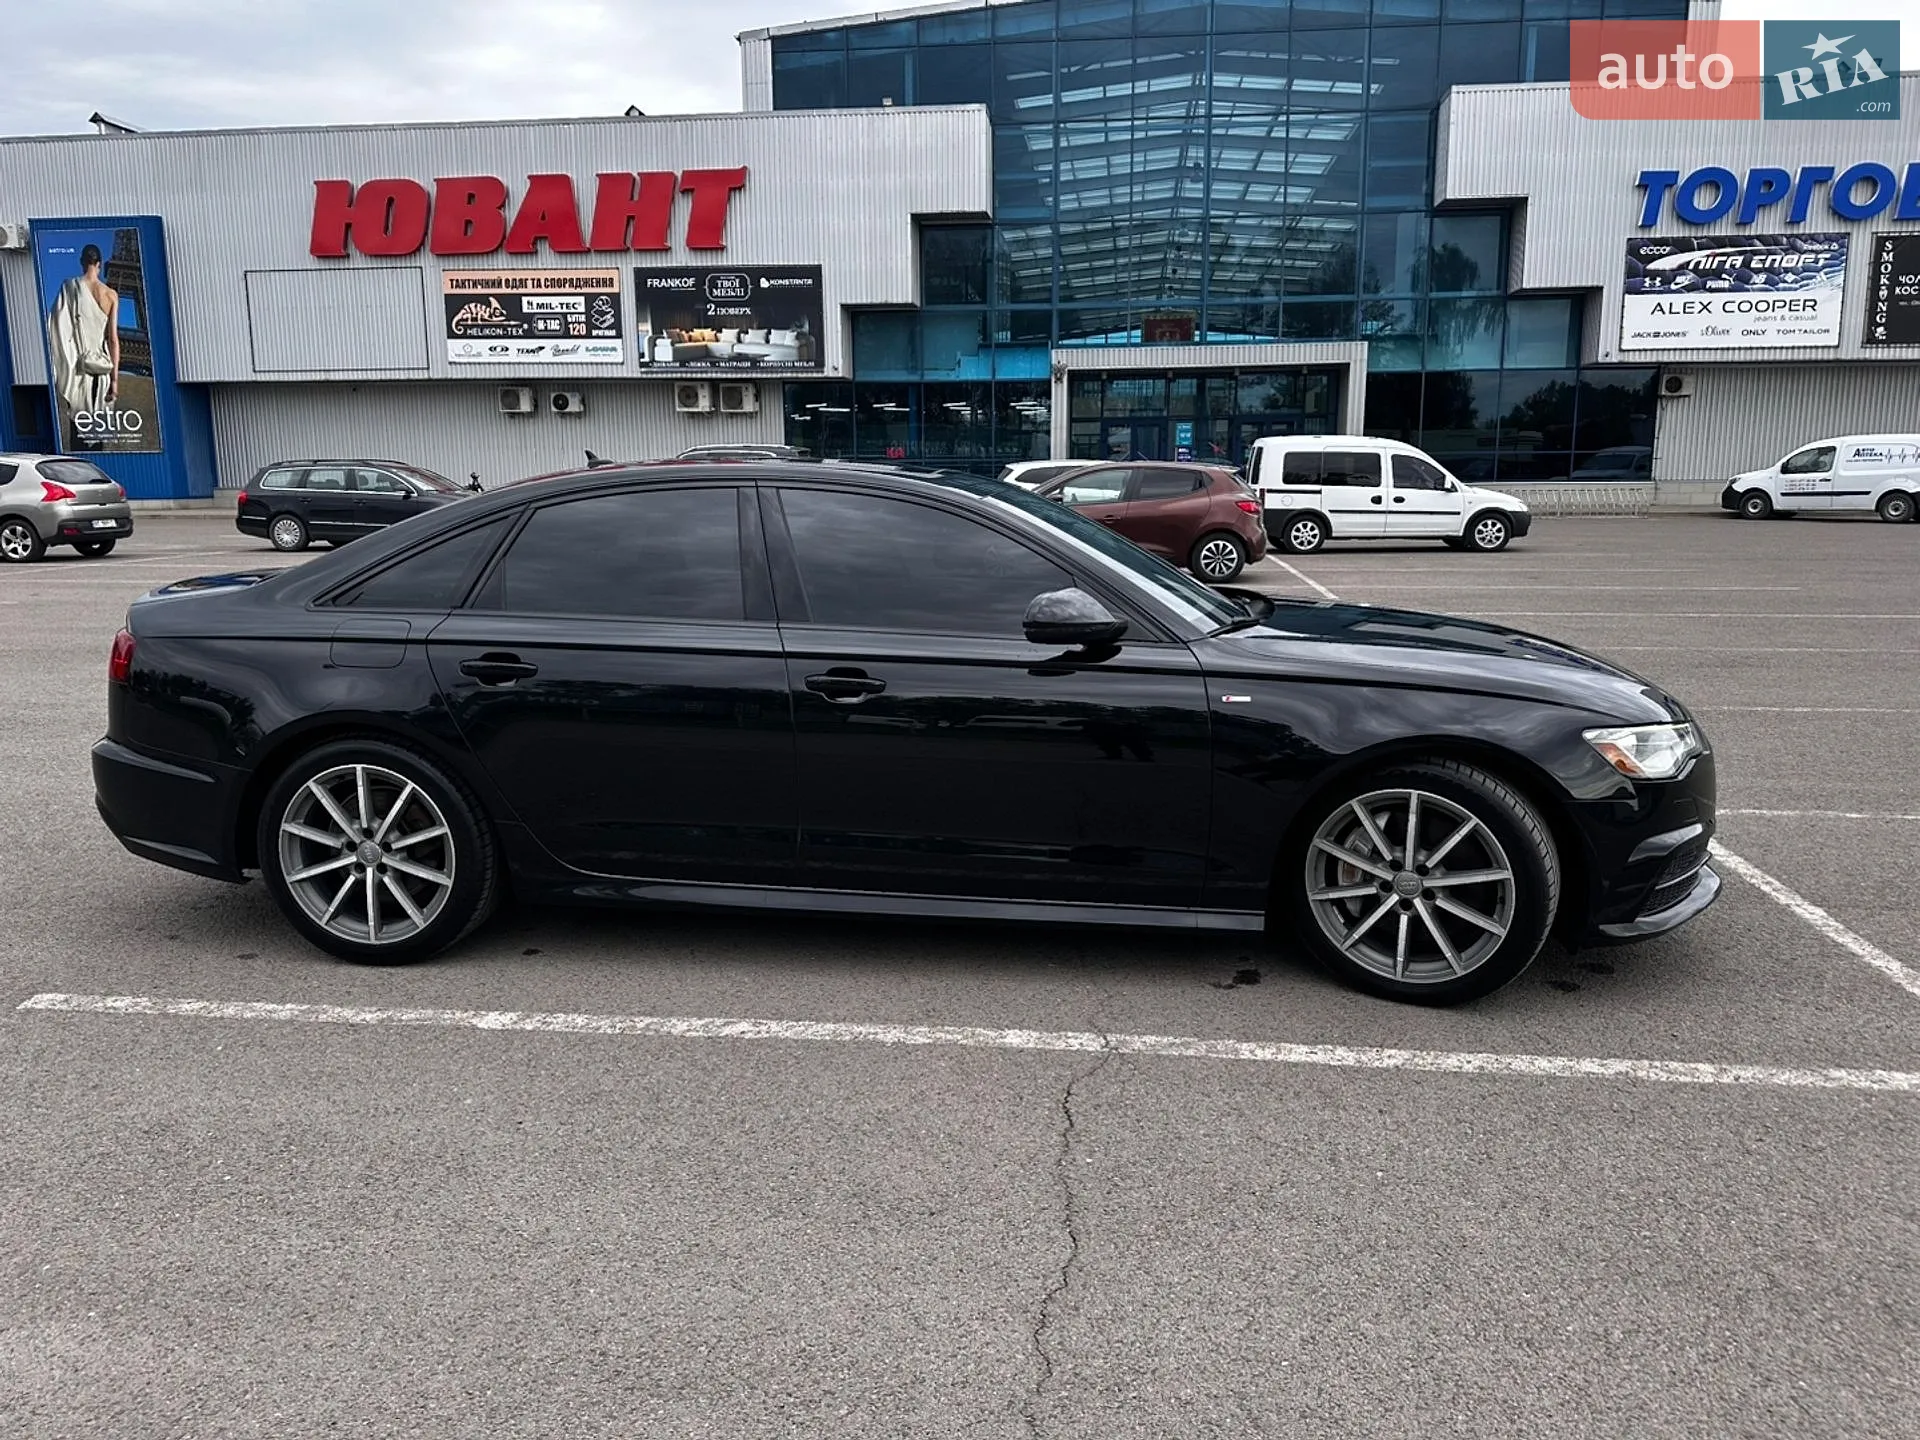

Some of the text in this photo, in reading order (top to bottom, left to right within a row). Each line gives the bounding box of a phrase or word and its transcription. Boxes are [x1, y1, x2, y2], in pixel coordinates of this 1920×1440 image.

[309, 165, 748, 258] ЮВАНТ
[1639, 245, 1671, 255] ecco
[449, 276, 614, 291] ТАКТИЧНИЙ ОДЯГ ТА СПОРЯДЖЕННЯ
[647, 277, 696, 288] FRANKOF
[716, 278, 740, 288] ТВОЇ
[712, 287, 745, 297] МЕБЛІ
[536, 302, 579, 311] MIL-TEC
[707, 303, 751, 316] 2 ПОВЕРХ
[1650, 298, 1818, 316] ALEX COOPER
[1754, 315, 1778, 324] jeans
[1788, 314, 1818, 322] casual
[466, 327, 524, 336] HELIKON-TEX
[568, 323, 587, 336] 120
[1741, 329, 1768, 337] ONLY
[74, 405, 143, 432] estro
